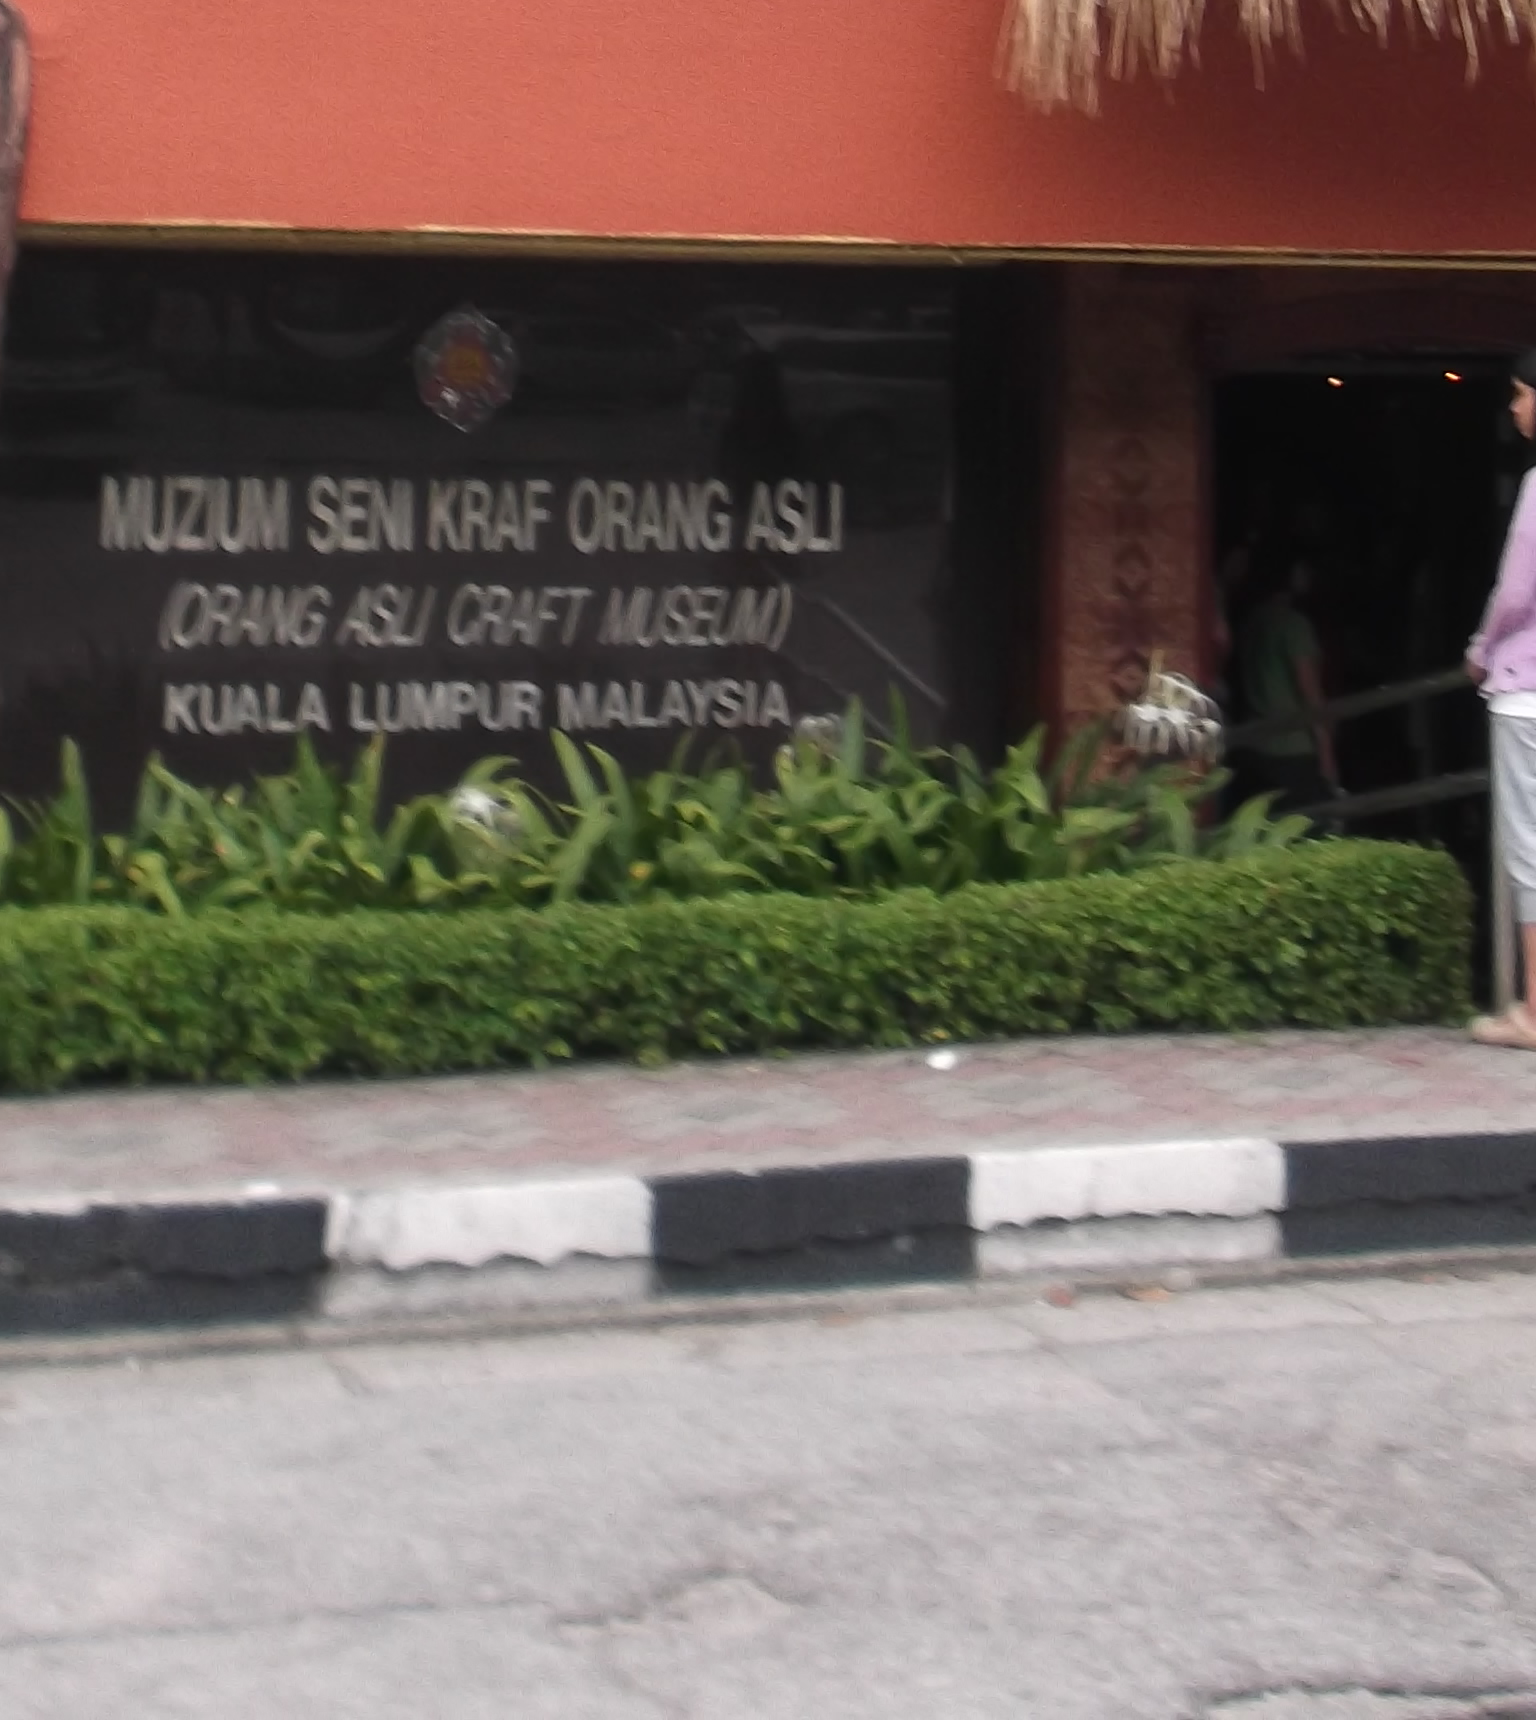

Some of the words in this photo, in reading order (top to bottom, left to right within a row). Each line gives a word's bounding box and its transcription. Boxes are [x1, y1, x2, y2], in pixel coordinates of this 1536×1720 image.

[98, 475, 291, 554] MUZIUM
[307, 476, 414, 554] SENI
[426, 478, 554, 553] KRAF
[567, 478, 734, 554] ORANG
[743, 479, 844, 555] ASLI
[159, 581, 334, 651] (ORANG
[332, 582, 439, 648] ASLI
[445, 582, 594, 648] CRAFT
[596, 582, 795, 652] MUSEUM)
[162, 681, 333, 736] KUALA
[347, 680, 543, 733] LUMPUR
[556, 677, 792, 731] MALAYSIA
